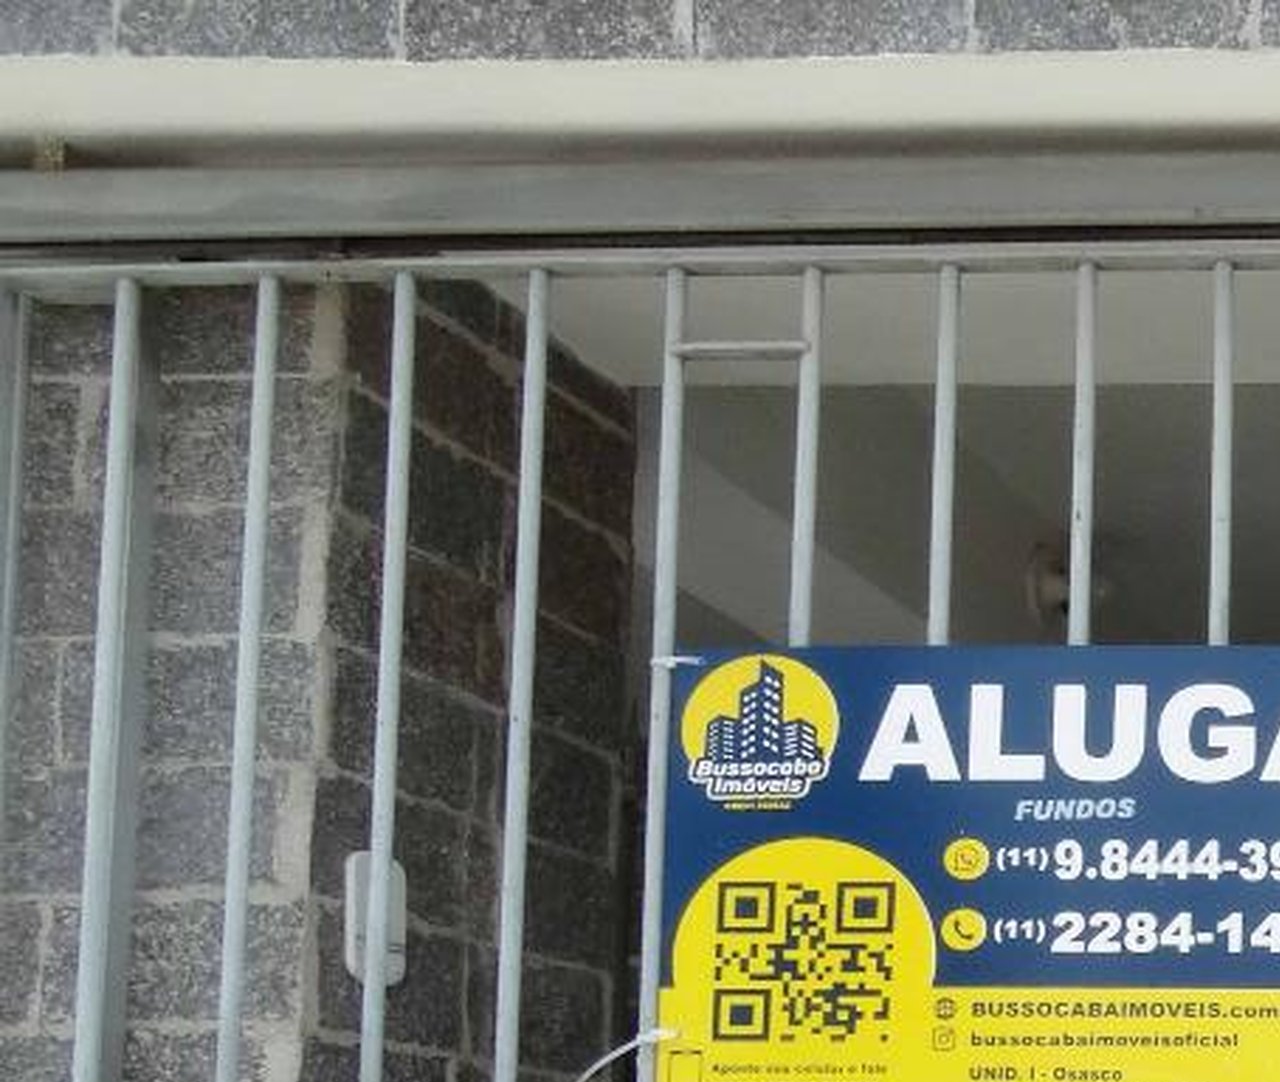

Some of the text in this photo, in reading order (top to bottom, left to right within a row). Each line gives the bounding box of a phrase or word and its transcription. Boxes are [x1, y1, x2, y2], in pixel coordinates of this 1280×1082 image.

[1014, 798, 1137, 821] FUNDOS
[997, 848, 1048, 872] (11)
[994, 919, 1046, 944] (11)
[970, 1033, 1239, 1048] bussocabaimoveisoficial
[1053, 1067, 1123, 1081] Osasco
